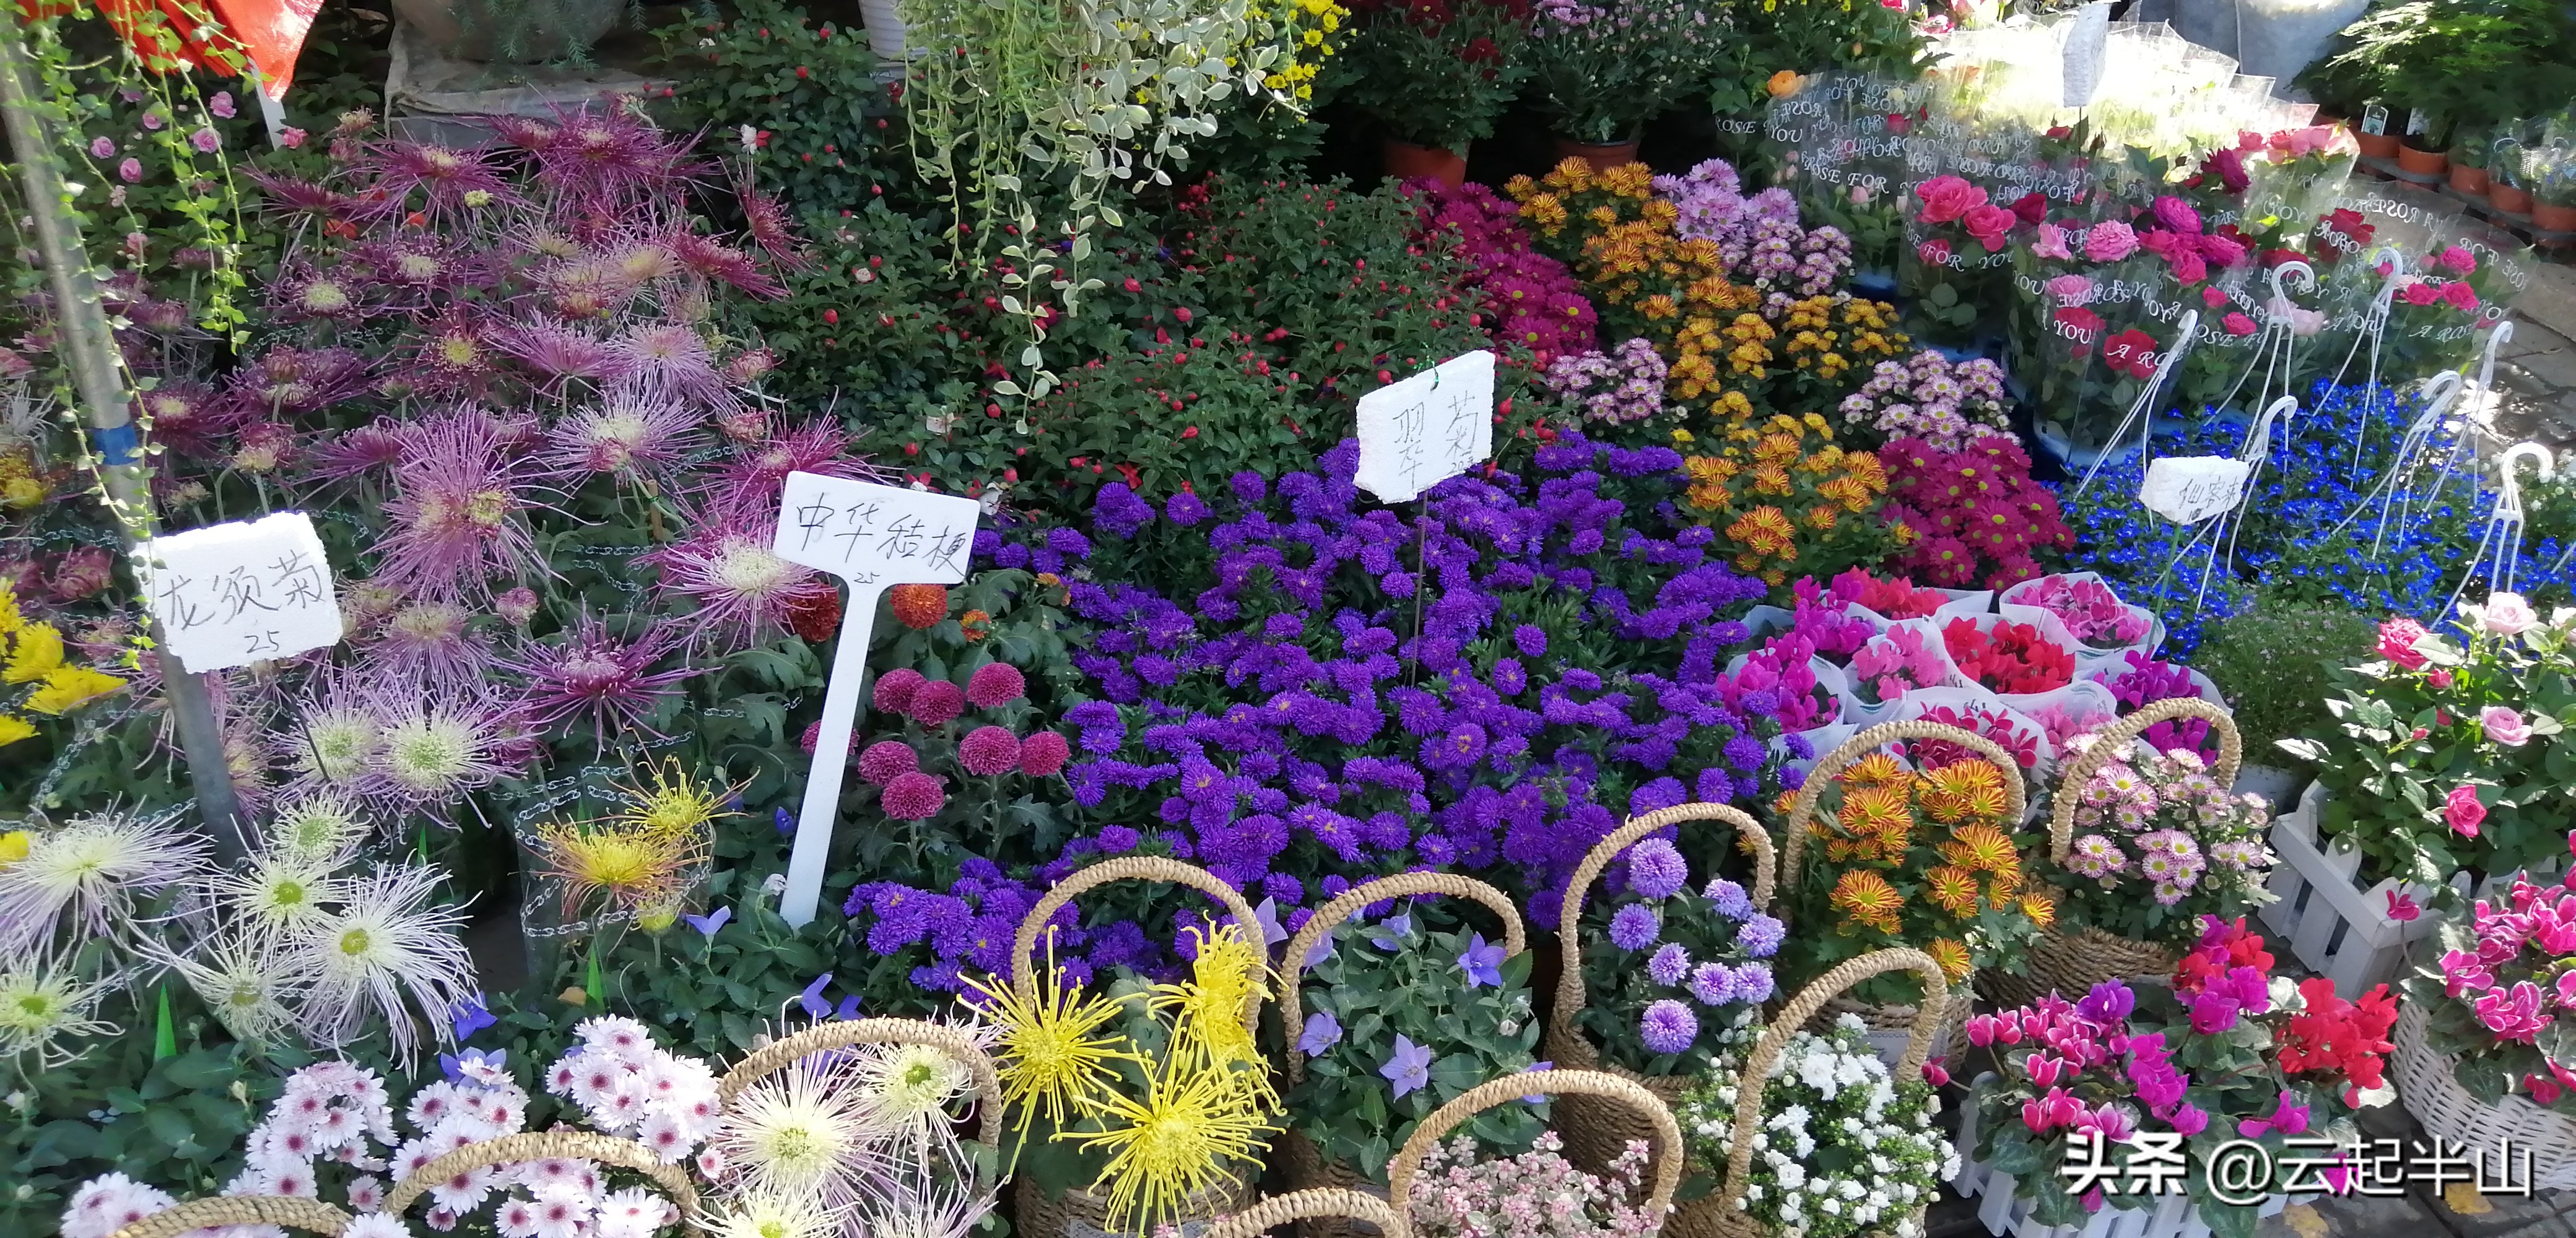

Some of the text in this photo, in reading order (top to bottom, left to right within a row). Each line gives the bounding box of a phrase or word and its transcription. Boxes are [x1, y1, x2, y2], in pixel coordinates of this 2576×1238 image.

[1770, 125, 1803, 143] YOU
[1848, 173, 1889, 194] FOR
[1925, 244, 1965, 272] FOR
[2013, 270, 2046, 295] YOU
[2053, 319, 2092, 345] YOU
[2408, 325, 2434, 338] A
[2107, 344, 2131, 359] A
[2178, 475, 2239, 509] 仙客来
[853, 571, 881, 584] 25
[159, 549, 326, 630] 龙须菊
[244, 630, 280, 653] 25
